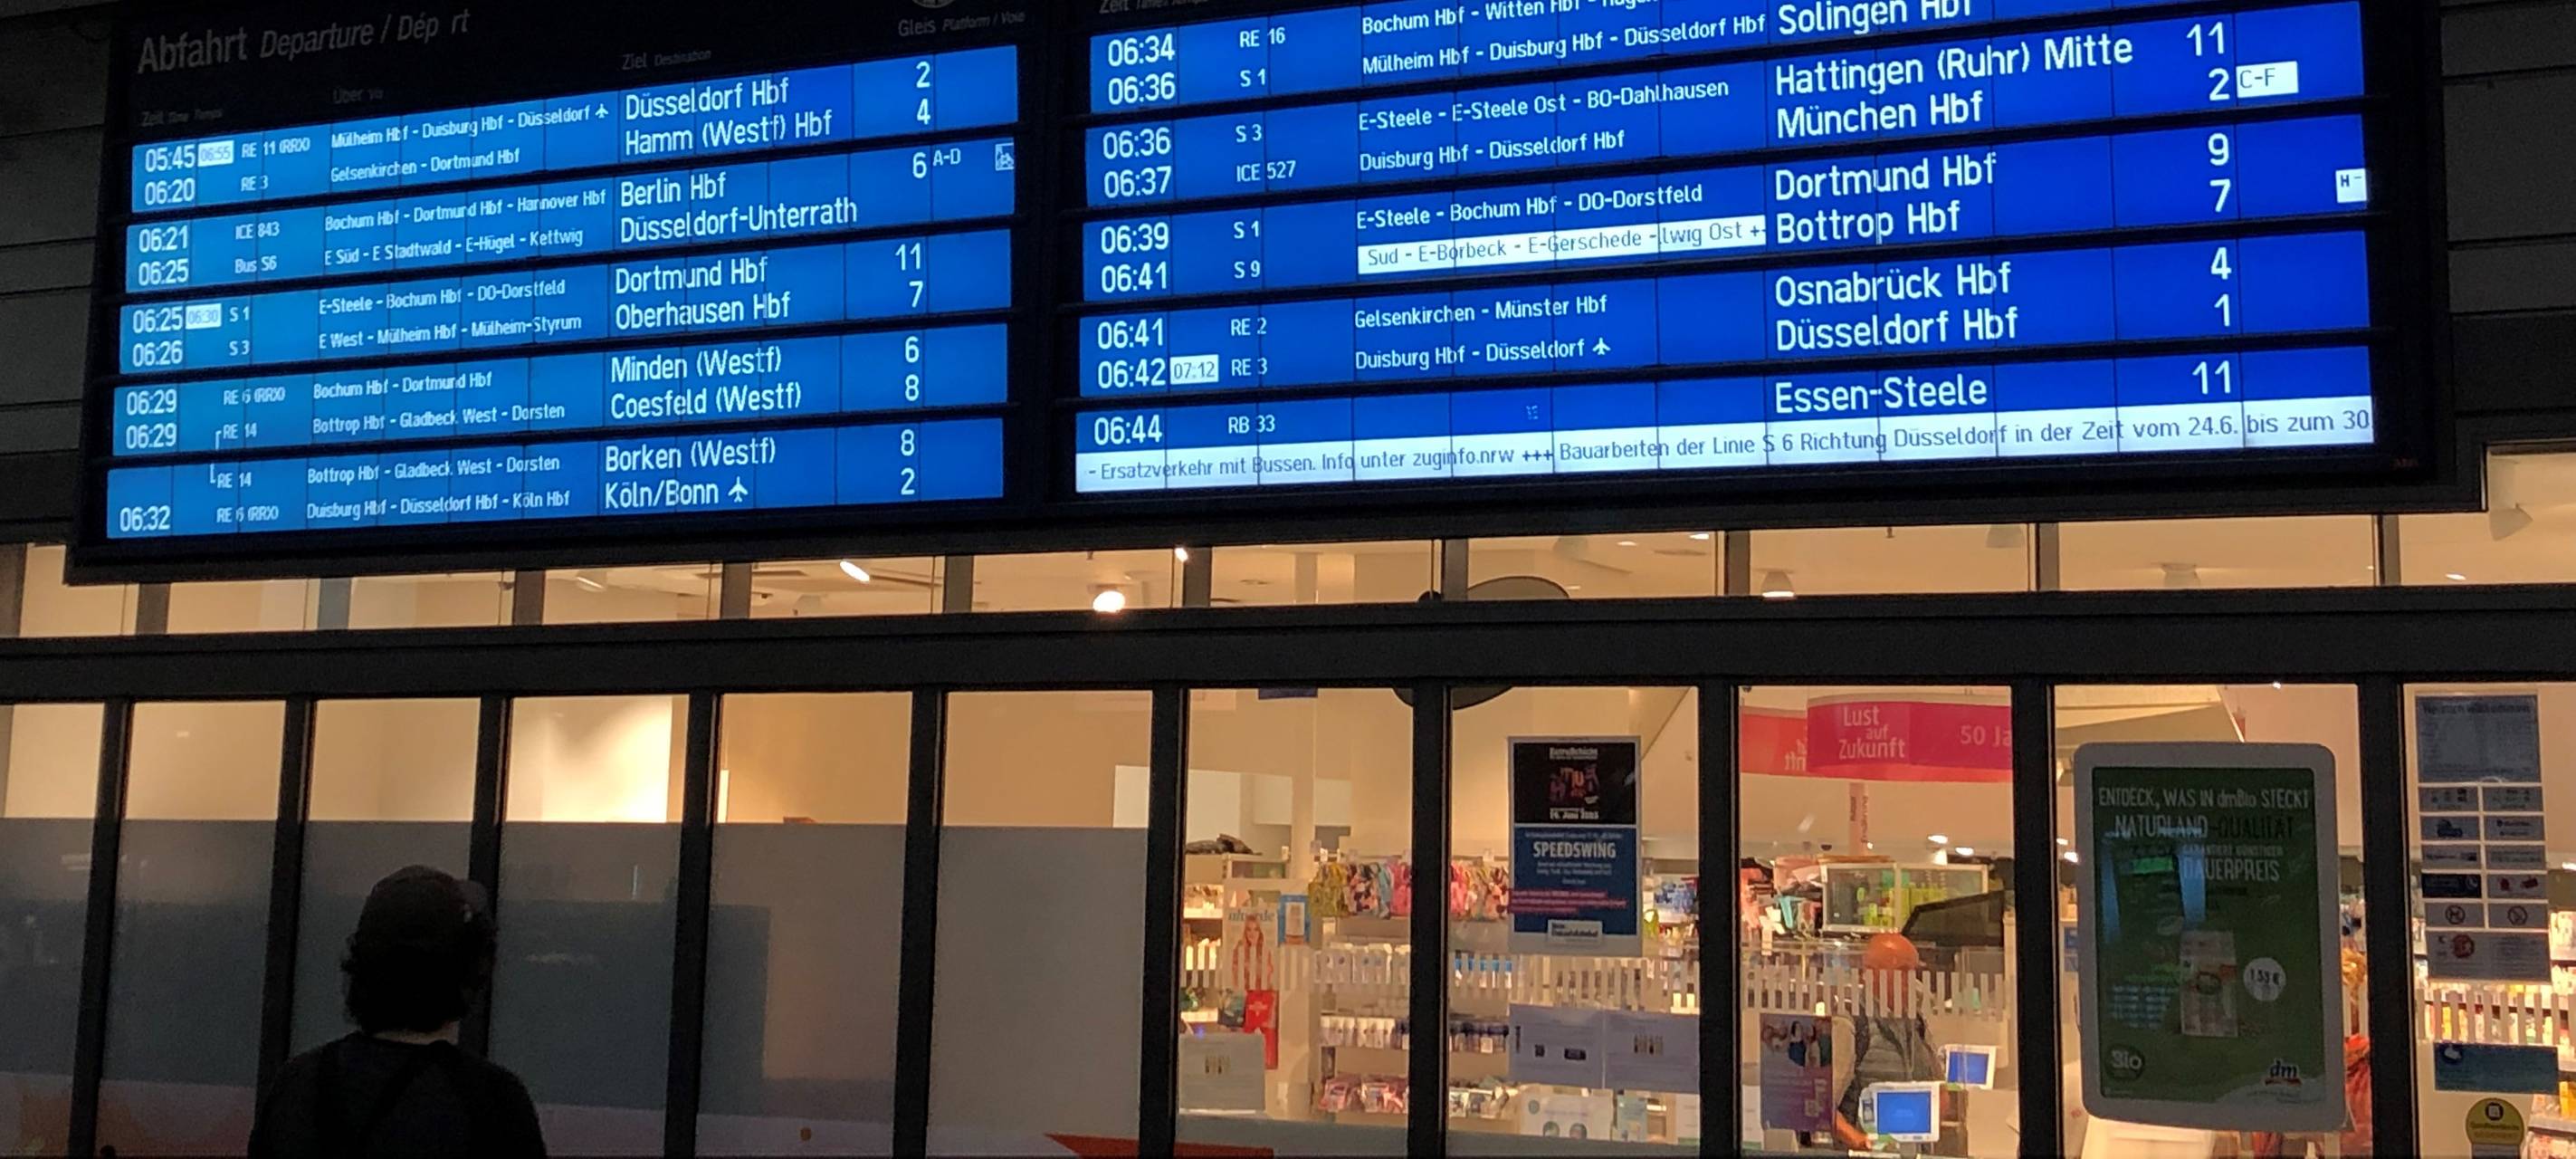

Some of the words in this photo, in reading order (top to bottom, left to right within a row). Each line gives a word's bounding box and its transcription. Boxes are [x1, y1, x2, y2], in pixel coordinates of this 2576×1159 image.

[898, 19, 936, 37] Gleis
[1779, 0, 1907, 34] Solingen
[1922, 0, 1970, 20] Hbf
[138, 26, 247, 73] Abfahrt
[260, 24, 374, 62] Departure
[1109, 34, 1175, 66] 06:34
[1240, 30, 1259, 47] RE
[1269, 27, 1285, 43] 16
[2187, 22, 2224, 55] 11
[622, 53, 646, 71] Ziel
[917, 62, 930, 88] 2
[1777, 60, 1922, 95] Hattingen
[1938, 42, 2029, 80] (Ruhr)
[2045, 34, 2132, 70] Mitte
[1109, 72, 1175, 104] 06:36
[2209, 68, 2229, 101] 2
[2239, 68, 2275, 88] C-F
[626, 82, 742, 120] Düsseldorf
[752, 78, 788, 106] Hbf
[917, 99, 930, 124] 4
[1360, 109, 1432, 130] E-Steele
[1453, 99, 1528, 121] E-Steele
[1534, 94, 1565, 113] Ost
[1588, 82, 1728, 108] BO-Dahlhausen
[331, 132, 383, 148] Mülheim
[386, 126, 408, 141] Hbf
[423, 121, 478, 138] Duisburg
[482, 115, 502, 130] Hbf
[519, 105, 589, 127] Düsseldorf
[1778, 101, 1916, 138] München
[1931, 91, 1982, 125] Hbf
[626, 130, 692, 155] Hamm
[702, 115, 785, 147] (Westf)
[796, 110, 832, 138] Hbf
[1103, 128, 1171, 159] 06:36
[146, 145, 196, 172] 05:45
[933, 148, 960, 166] A-D
[2209, 133, 2228, 166] 9
[331, 161, 416, 182] Gelsenkirchen
[431, 151, 493, 171] Dortmund
[498, 148, 520, 164] Hbf
[913, 152, 927, 178] 6
[1237, 164, 1260, 181] ICE
[1267, 160, 1295, 179] 527
[1776, 158, 1929, 200] Dortmund
[1943, 152, 1996, 187] Hbf
[145, 178, 195, 205] 06:20
[622, 178, 681, 206] Berlin
[691, 172, 725, 199] Hbf
[1104, 166, 1171, 197] 06:37
[2210, 179, 2230, 212] 7
[622, 197, 856, 243] Düsseldorf-Unterrath
[1358, 207, 1430, 228] E-Steele
[1451, 202, 1520, 221] Bochum
[1527, 196, 1556, 215] Hbf
[1579, 184, 1702, 211] DO-Dorstfeld
[236, 224, 253, 239] ICE
[258, 222, 280, 237] 843
[1777, 209, 1894, 244] Bottrop
[1908, 200, 1960, 234] Hbf
[139, 225, 187, 252] 06:21
[1102, 223, 1169, 254] 06:39
[1418, 240, 1506, 262] E-Borbeck
[1530, 232, 1641, 254] E-Gerschede
[1709, 223, 1743, 241] Ost
[139, 259, 188, 285] 06:25
[235, 259, 257, 273] Bus
[262, 255, 276, 271] S6
[896, 244, 920, 270] 11
[2211, 247, 2231, 279] 4
[616, 261, 721, 293] Dortmund
[731, 257, 768, 284] Hbf
[1102, 262, 1166, 292] 06:41
[1776, 267, 1942, 306] Osnabrück
[1957, 262, 2010, 295] Hbf
[134, 306, 183, 333] 06:25
[616, 302, 743, 330] Oberhausen
[754, 292, 790, 319] Hbf
[1355, 305, 1474, 328] Gelsenkirchen
[1496, 299, 1569, 319] Münster
[1577, 295, 1607, 313] Hbf
[1098, 319, 1162, 349] 06:41
[1777, 311, 1948, 350] Düsseldorf
[1964, 307, 2018, 340] Hbf
[133, 340, 182, 367] 06:26
[612, 355, 687, 382] Minden
[697, 346, 781, 376] (Westf)
[1099, 358, 1166, 388] 06:42
[1174, 361, 1215, 379] 07:12
[2193, 360, 2230, 394] 11
[127, 389, 177, 415] 06:29
[612, 388, 706, 418] Coesfeld
[716, 382, 800, 412] (Westf)
[1776, 374, 1987, 413] Essen-Steele
[127, 423, 177, 448] 06:29
[1095, 415, 1162, 445] 06:44
[1228, 417, 1249, 434] RB
[1258, 415, 1274, 432] 33
[606, 445, 681, 472] Borken
[692, 437, 775, 466] (Westf)
[1102, 459, 1212, 480] Ersatzverkehr
[1219, 457, 1246, 475] mit
[1253, 455, 1315, 474] Bussen.
[1322, 453, 1354, 472] Info
[1361, 452, 1405, 469] unter
[1412, 448, 1515, 471] zuginfo.nrw
[1522, 449, 1554, 463] +++
[1560, 440, 1668, 461] Bauarbeiten
[1676, 437, 1703, 455] der
[1713, 436, 1756, 454] Linie
[1763, 434, 1774, 452] S
[1782, 434, 1793, 451] 6
[1801, 430, 1886, 453] Richtung
[1894, 425, 2007, 448] Düsseldorf
[2015, 424, 2033, 443] in
[2040, 422, 2073, 442] der
[2083, 420, 2123, 440] Zeit
[2132, 421, 2180, 438] vom
[2189, 416, 2238, 436] 24.6.
[2247, 413, 2278, 434] bis
[2287, 415, 2334, 432] zum
[606, 480, 718, 508] Köln/Bonn
[120, 505, 170, 532] 06:32
[1844, 706, 1879, 726] Lust
[1866, 726, 1888, 740] auf
[1961, 726, 1985, 745] 50
[1839, 739, 1904, 759] Zukunft
[2098, 787, 2161, 810] ENTDECK,
[2163, 789, 2196, 807] WAS
[2200, 789, 2214, 807] IN
[2261, 789, 2309, 809] STECKT
[1533, 841, 1617, 858] SPEEDSWING
[2183, 858, 2280, 882] DAUERPREIS
[2270, 1060, 2298, 1078] dm
